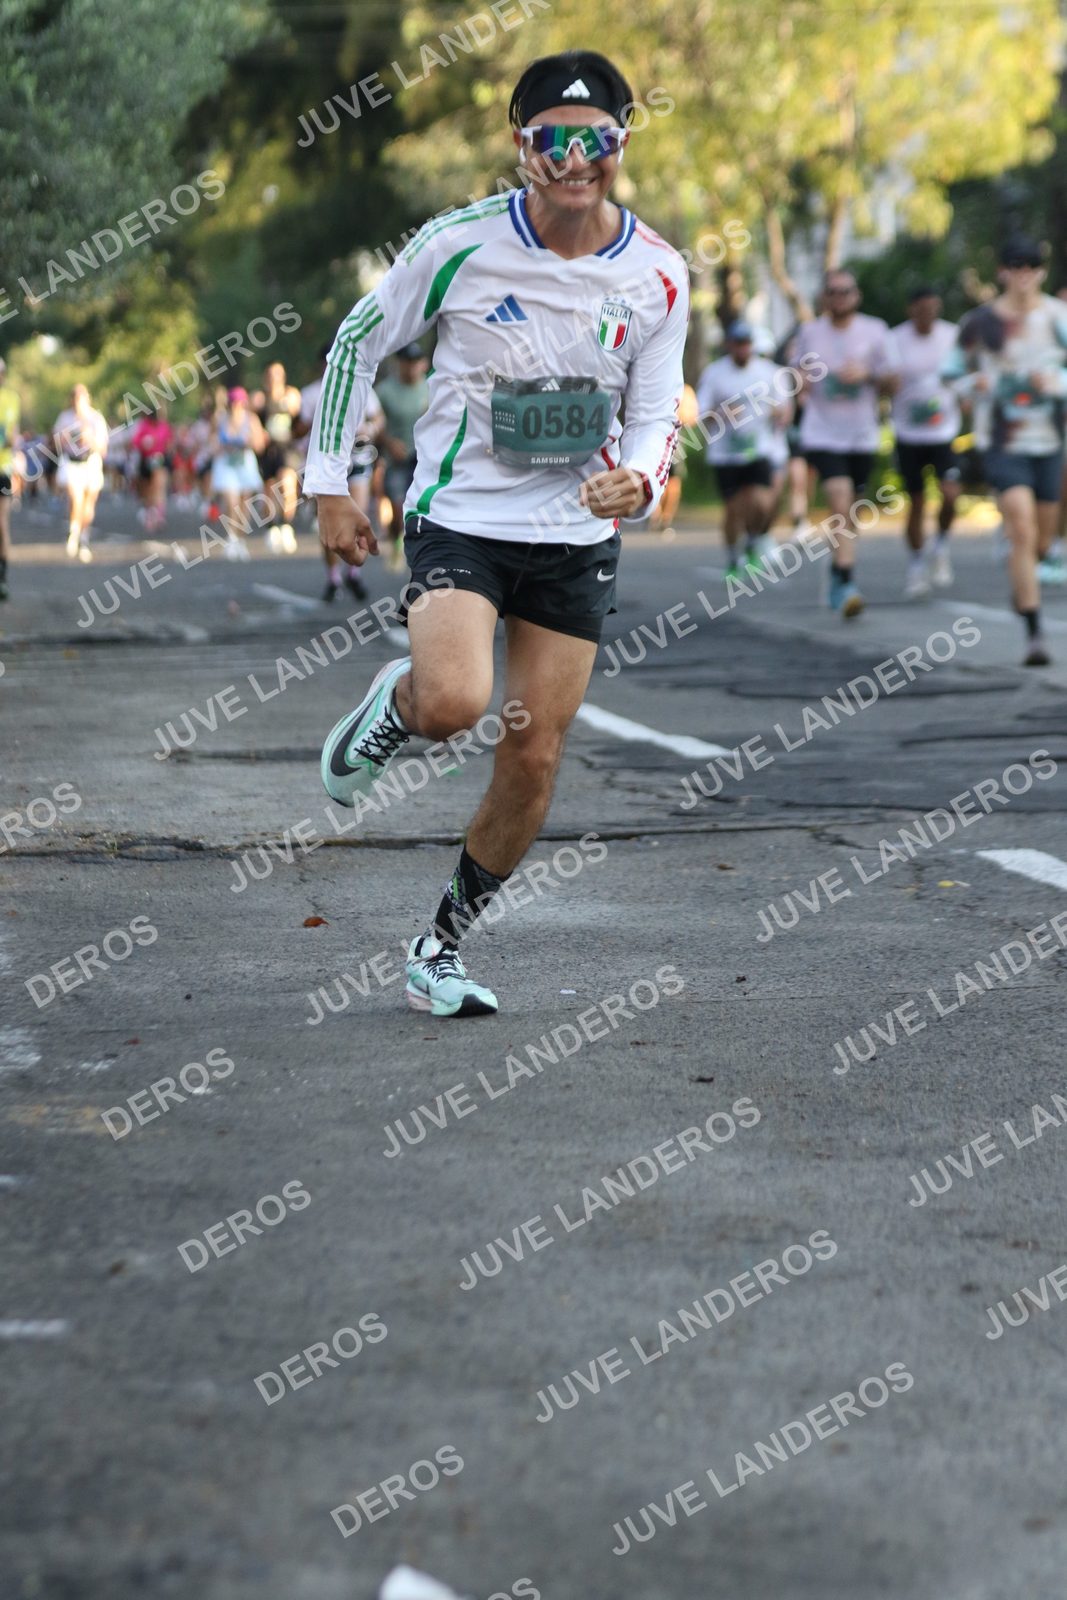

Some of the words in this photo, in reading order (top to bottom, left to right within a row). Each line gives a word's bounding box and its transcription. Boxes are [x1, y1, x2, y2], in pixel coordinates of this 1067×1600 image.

[603, 306, 628, 319] ITALIA
[522, 403, 607, 440] 0584
[530, 456, 570, 464] SAMSUNG
